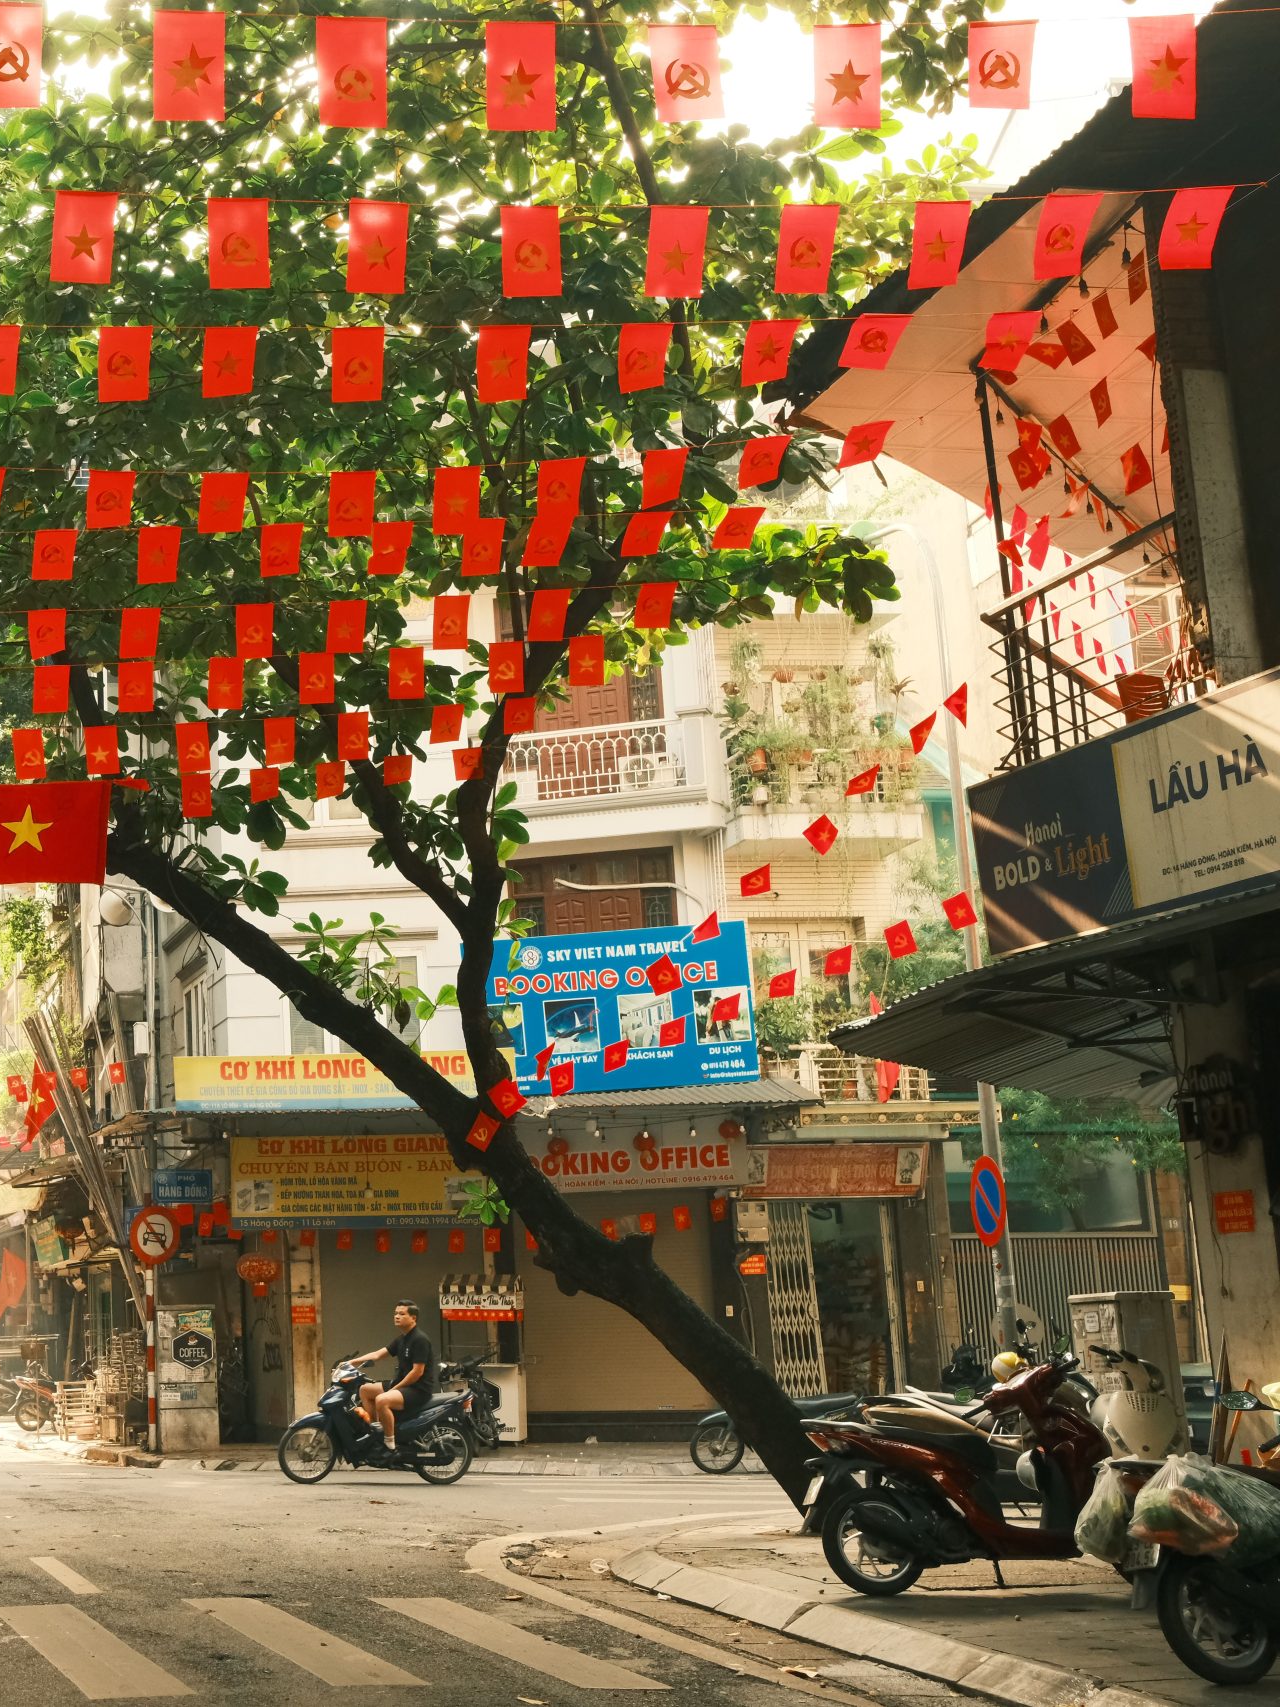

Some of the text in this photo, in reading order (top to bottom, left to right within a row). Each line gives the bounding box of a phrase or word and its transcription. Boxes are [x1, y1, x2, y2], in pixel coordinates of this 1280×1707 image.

[1149, 734, 1268, 814] LẨU HÀ
[1025, 812, 1063, 847] Hanoi
[1254, 838, 1264, 849] HÀ
[993, 832, 1112, 891] BOLD & Light
[546, 940, 687, 963] SKY VIET NAM TRAVEL
[493, 960, 718, 998] BOOKING OICE
[627, 1049, 673, 1060] KHÁCH SẠN
[708, 1045, 742, 1056] DU LỊCH
[220, 1056, 366, 1080] CƠ KHÍ LONG
[583, 1055, 598, 1064] BAY
[352, 1083, 368, 1094] INOX
[331, 1138, 387, 1154] LONG
[394, 1137, 449, 1153] GIAN
[239, 1160, 308, 1175] CHUYÊN
[314, 1158, 349, 1174] BÁN
[354, 1158, 401, 1173] BUÔN
[417, 1157, 452, 1172] BÁN
[640, 1144, 730, 1172] OFFICE
[645, 1176, 681, 1185] HOTLINE:
[682, 1175, 701, 1183] 0916
[702, 1174, 717, 1182] 479
[719, 1174, 734, 1182] 464
[159, 1183, 182, 1197] HÀNG
[179, 1347, 205, 1358] COFFEE
